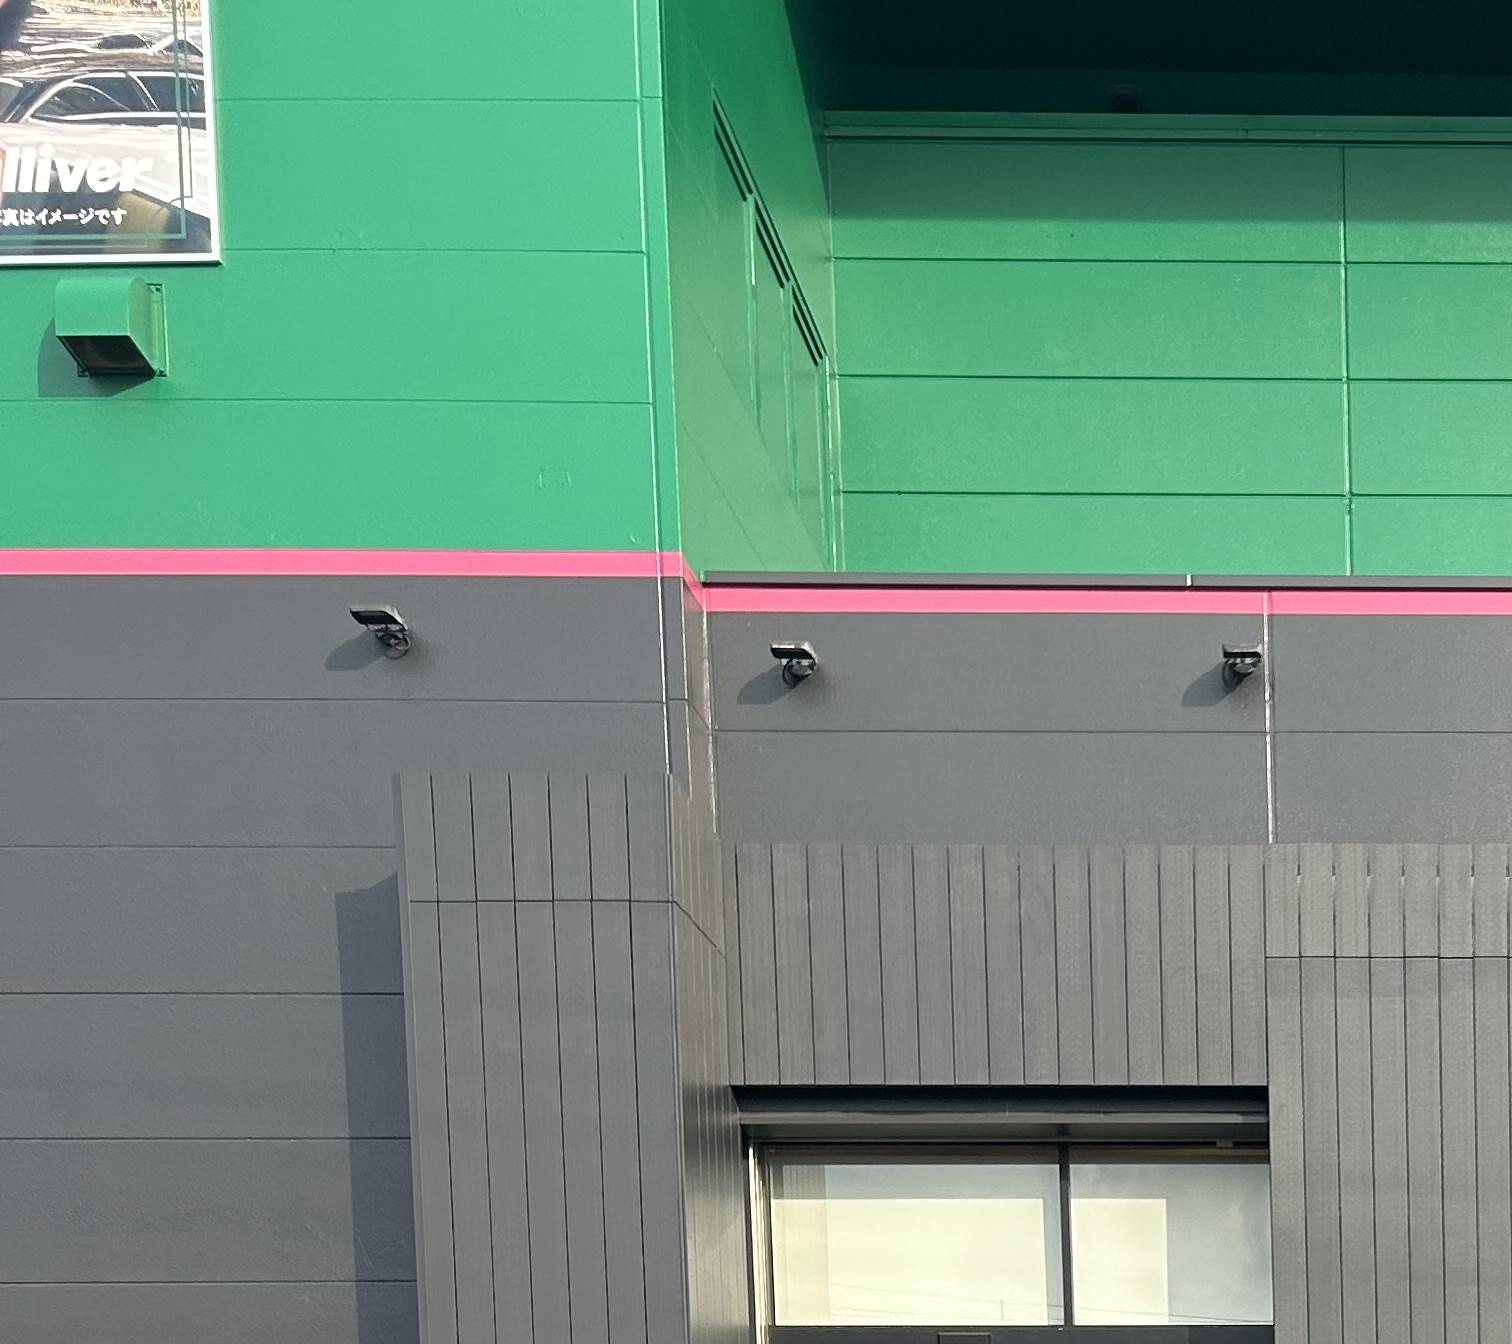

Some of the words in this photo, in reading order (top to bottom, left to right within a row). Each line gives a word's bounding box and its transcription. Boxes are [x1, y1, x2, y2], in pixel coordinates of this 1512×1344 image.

[2, 144, 153, 193] lliver
[0, 208, 128, 227] 真はイメージです
